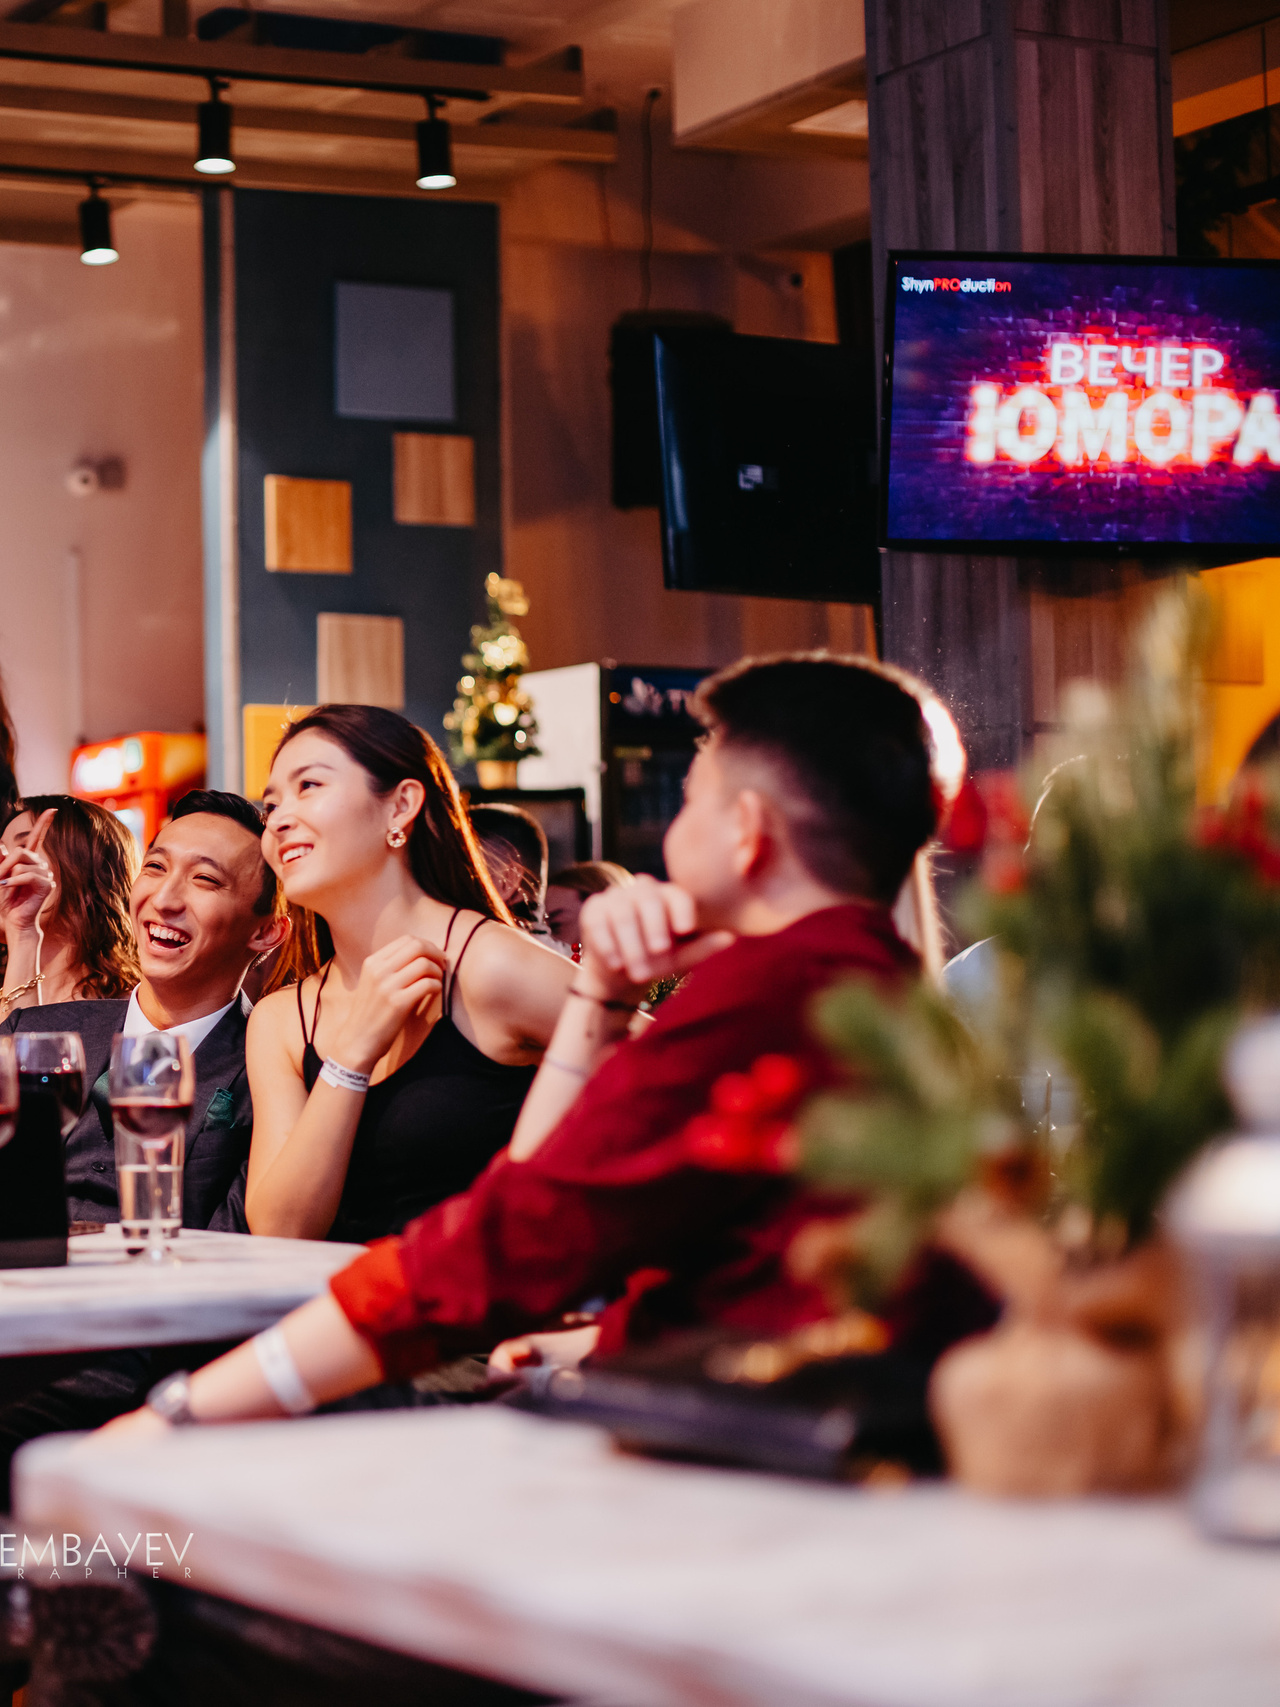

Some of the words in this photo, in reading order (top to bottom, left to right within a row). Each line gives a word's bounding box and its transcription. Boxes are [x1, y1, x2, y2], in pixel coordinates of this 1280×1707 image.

[901, 276, 1012, 294] ShynPROduction
[1049, 342, 1225, 388] ВЕЧЕР
[970, 385, 1280, 465] ЮМОРА
